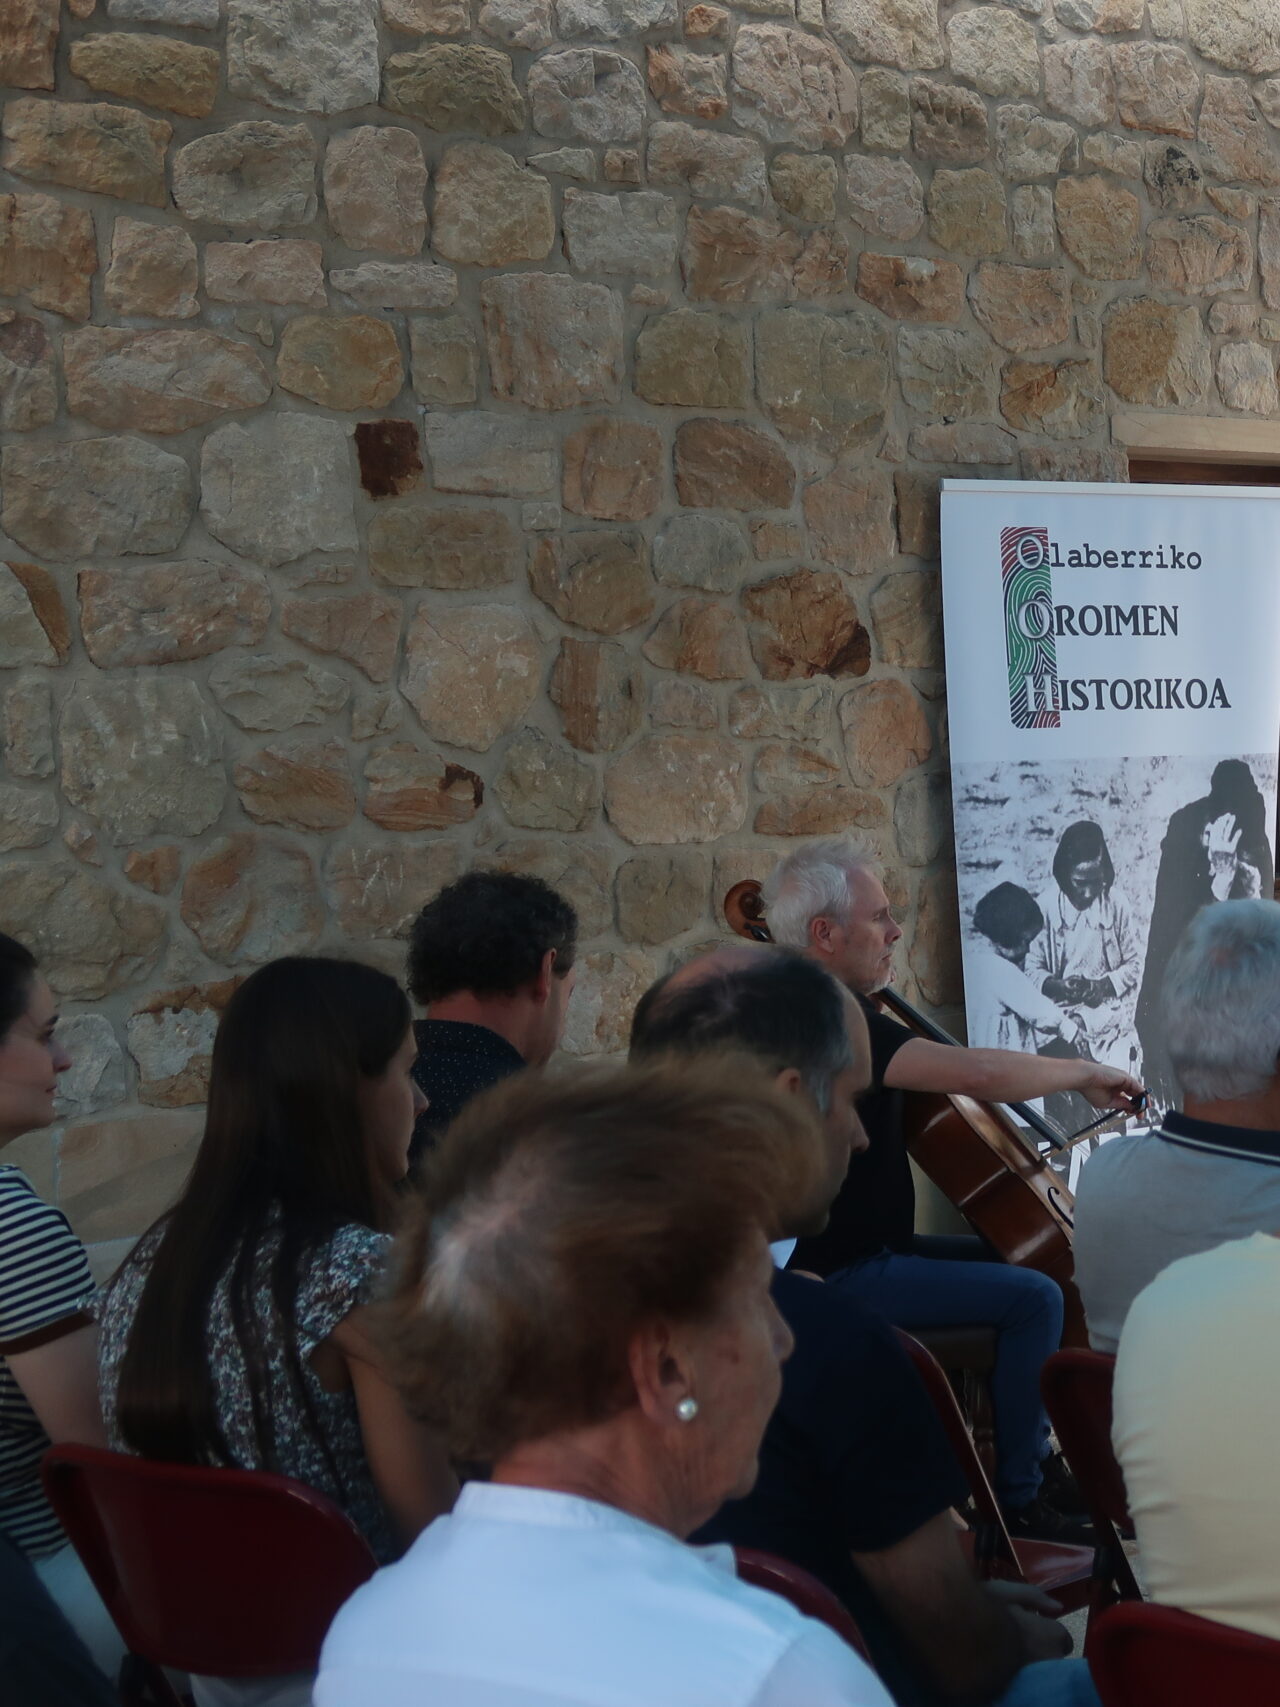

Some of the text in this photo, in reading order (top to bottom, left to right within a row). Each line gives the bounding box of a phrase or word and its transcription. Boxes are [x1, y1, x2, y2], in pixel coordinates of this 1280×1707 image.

[1017, 535, 1202, 570] Olaberriko
[1018, 600, 1179, 639] OROIMEN
[1022, 672, 1232, 712] HISTORIKOA
